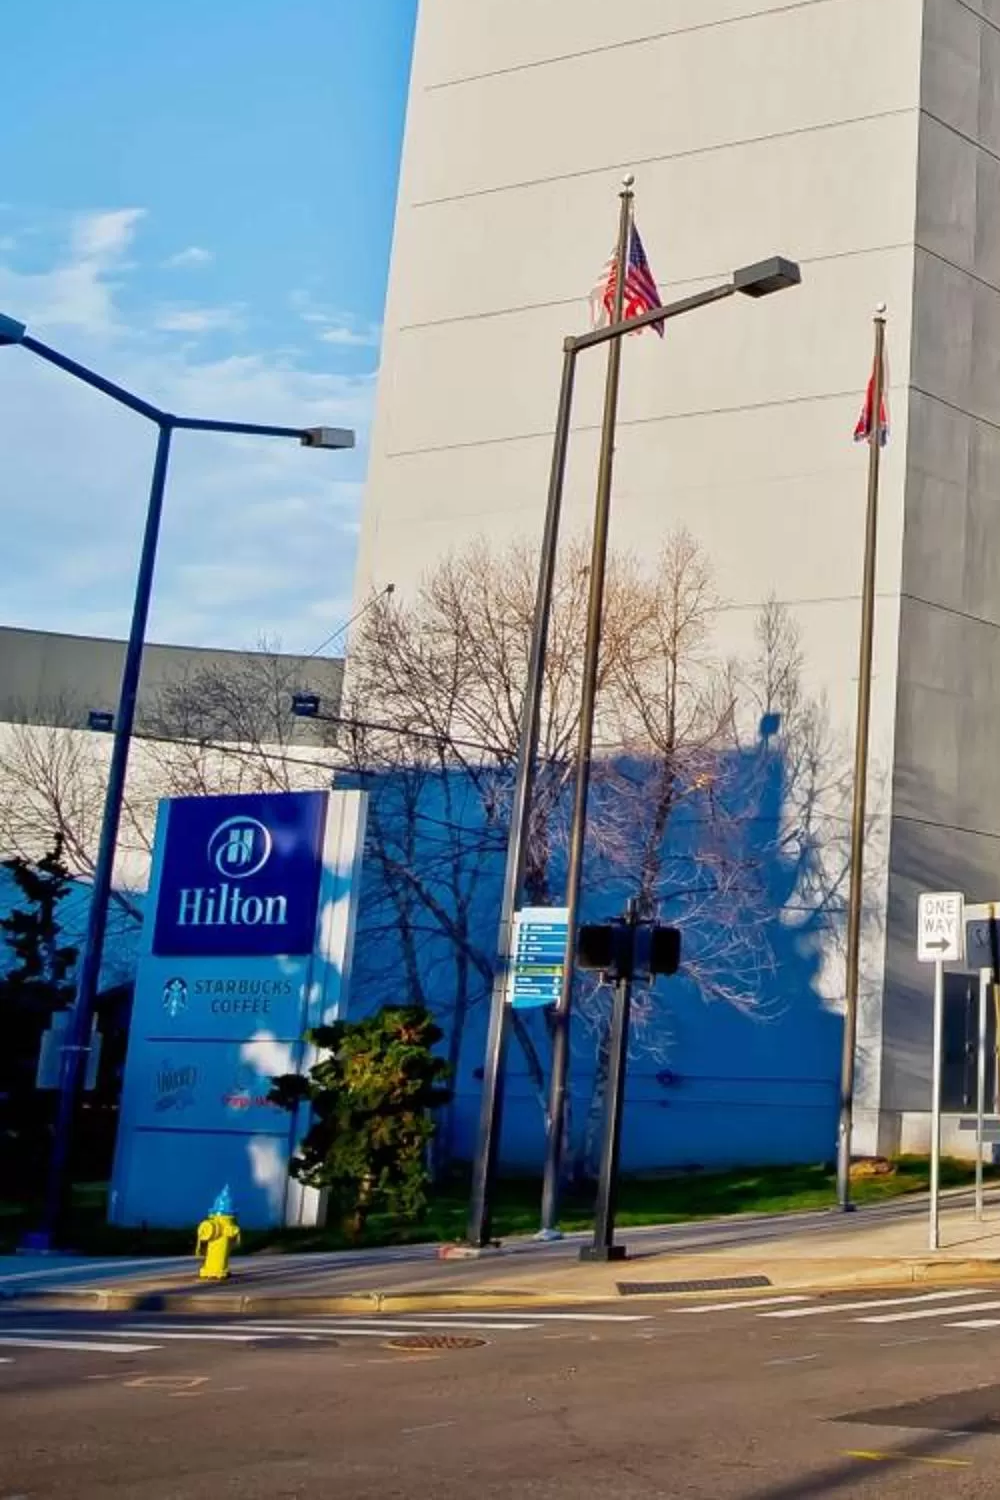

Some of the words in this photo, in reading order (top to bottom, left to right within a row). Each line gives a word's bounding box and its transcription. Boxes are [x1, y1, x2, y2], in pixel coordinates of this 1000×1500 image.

[176, 883, 288, 925] Hilton
[925, 900, 955, 915] ONE
[925, 918, 954, 933] WAY
[194, 979, 292, 996] STARBUCKS
[211, 999, 271, 1014] COFFEE
